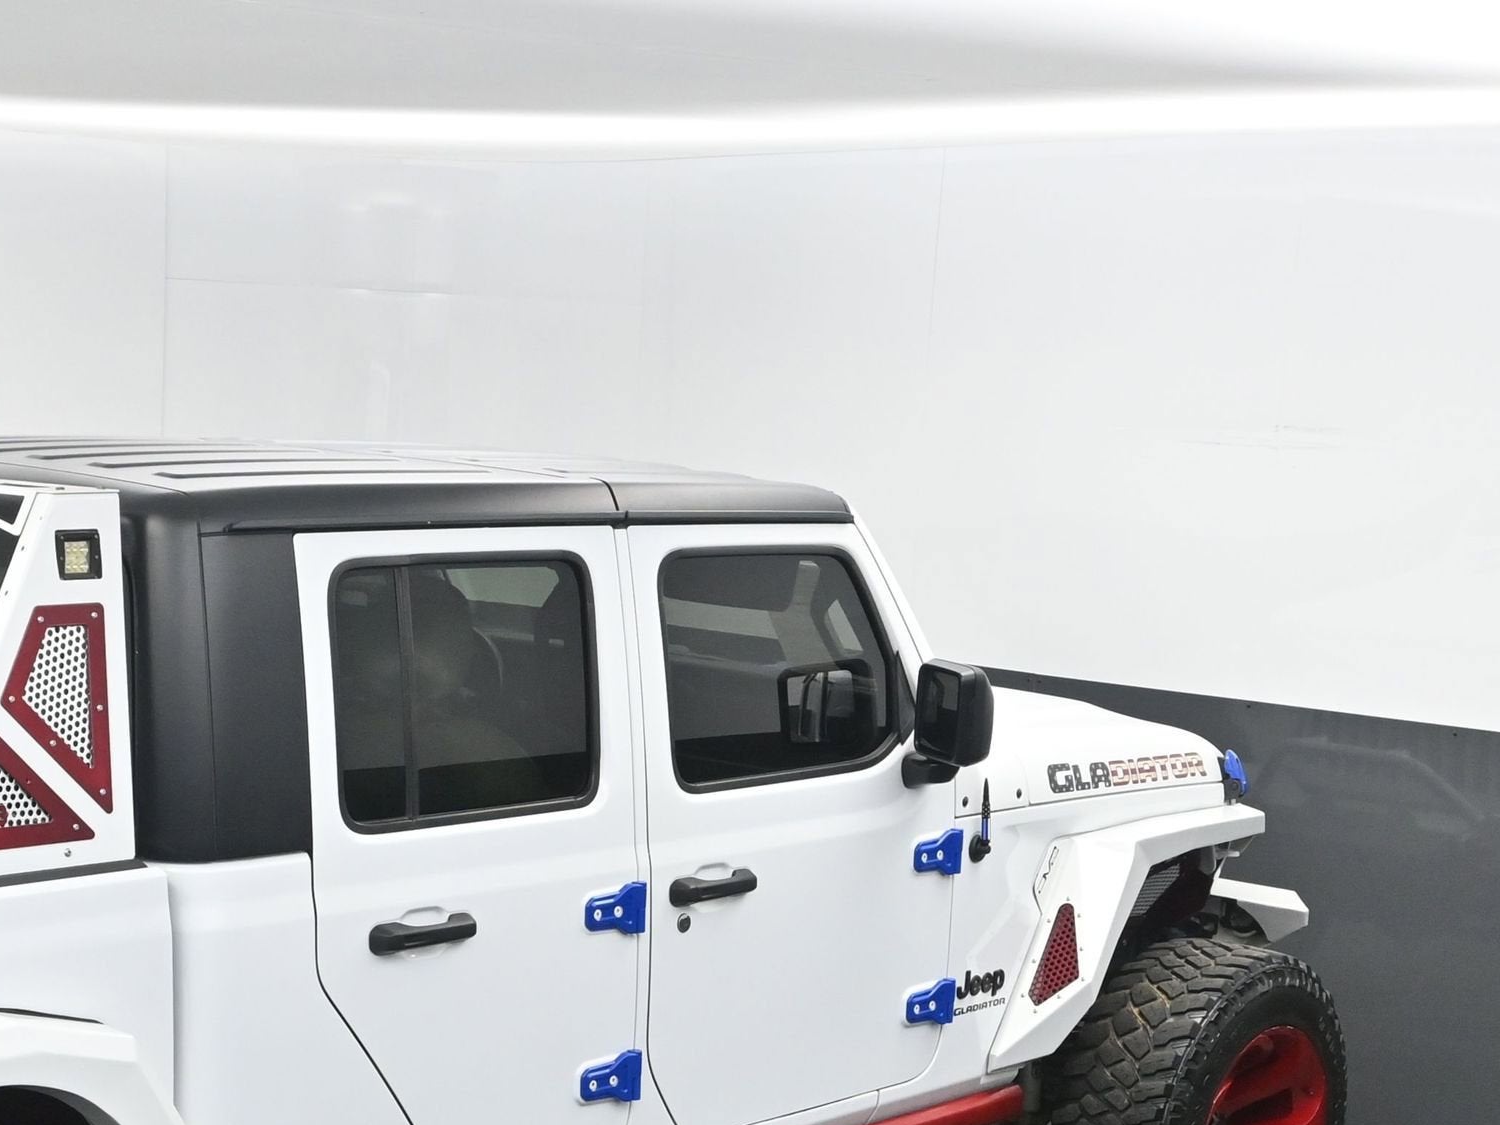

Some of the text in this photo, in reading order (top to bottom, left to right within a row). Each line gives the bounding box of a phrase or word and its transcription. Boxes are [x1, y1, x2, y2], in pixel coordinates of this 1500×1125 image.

[1047, 752, 1207, 794] GLADIATOR
[956, 968, 1005, 1000] Jeep
[953, 997, 1006, 1017] GLADIATOR
